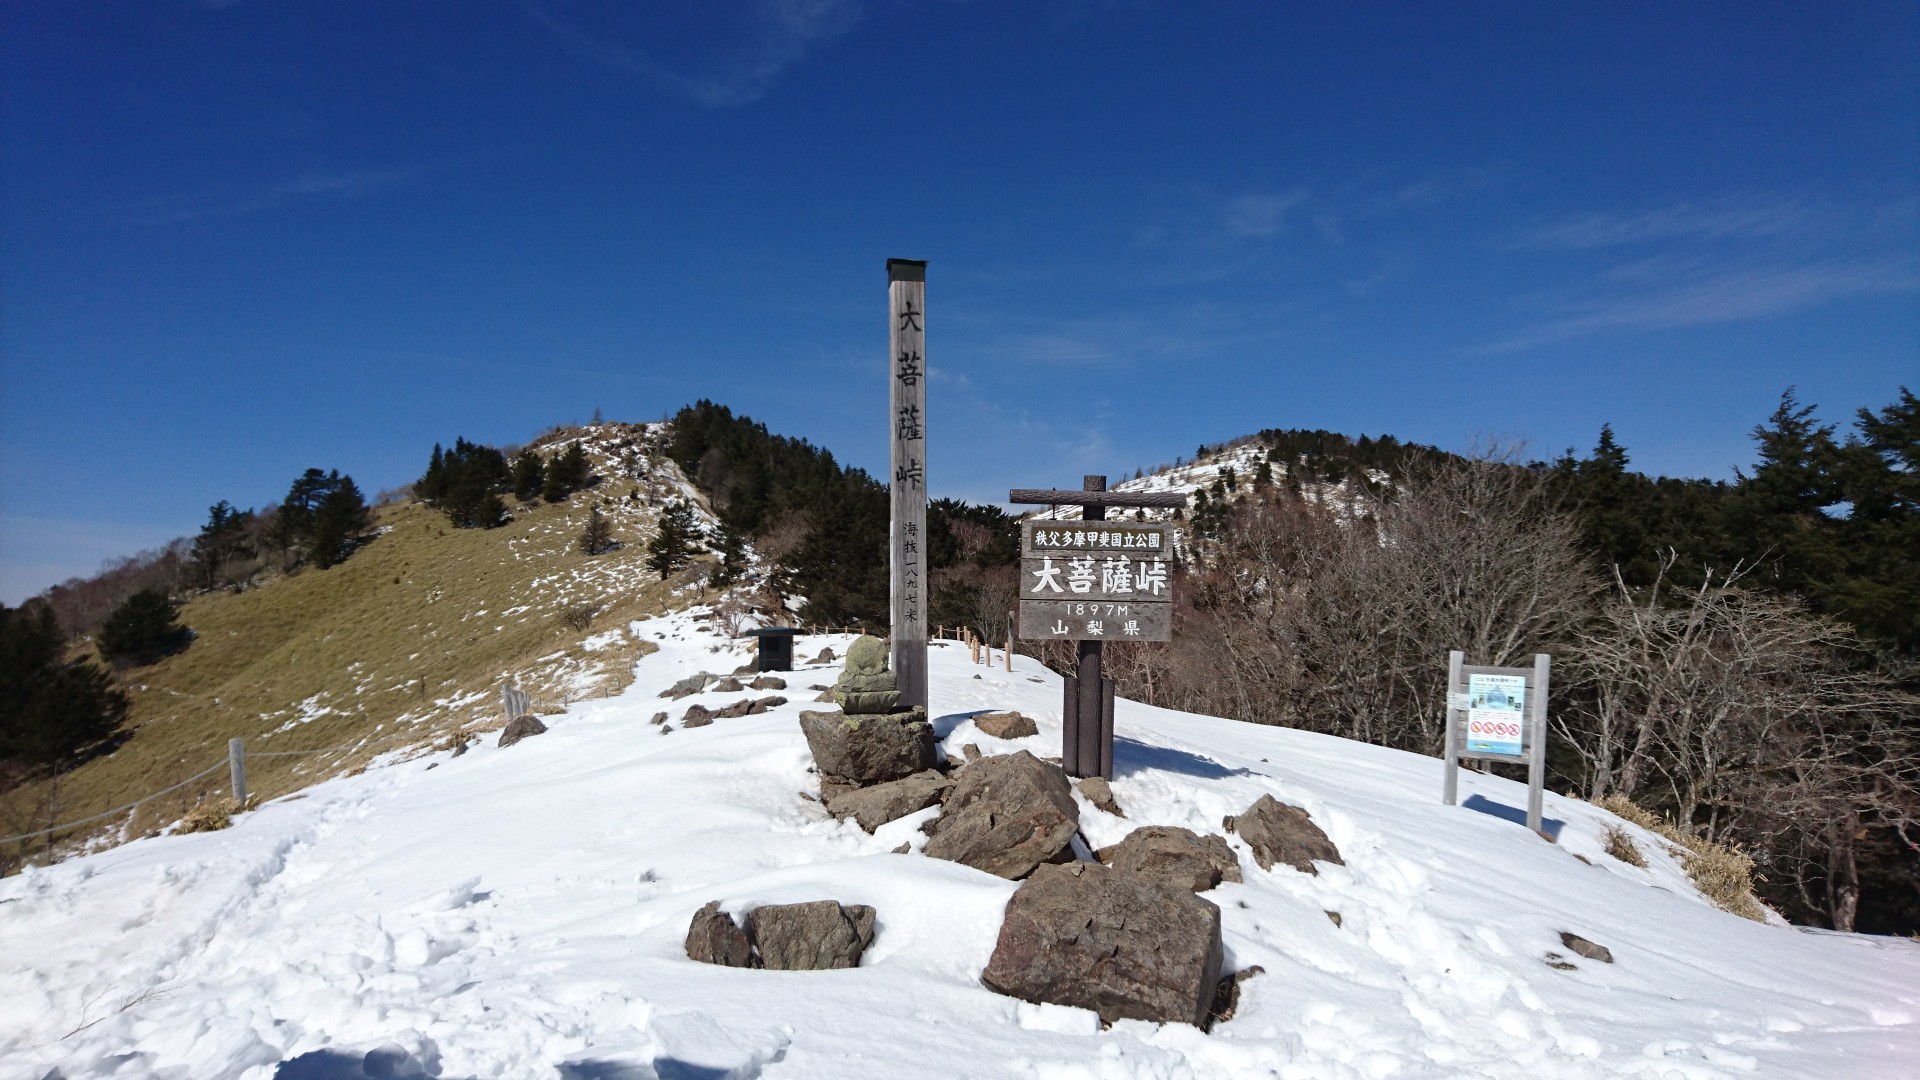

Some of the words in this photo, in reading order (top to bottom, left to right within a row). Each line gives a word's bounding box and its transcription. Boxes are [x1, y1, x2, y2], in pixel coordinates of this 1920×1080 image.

[896, 301, 922, 491] 大菩薩峠
[1034, 530, 1160, 548] 秩父多摩甲斐国立公園
[1031, 554, 1167, 595] 大菩薩峠
[1066, 604, 1128, 616] 1897M
